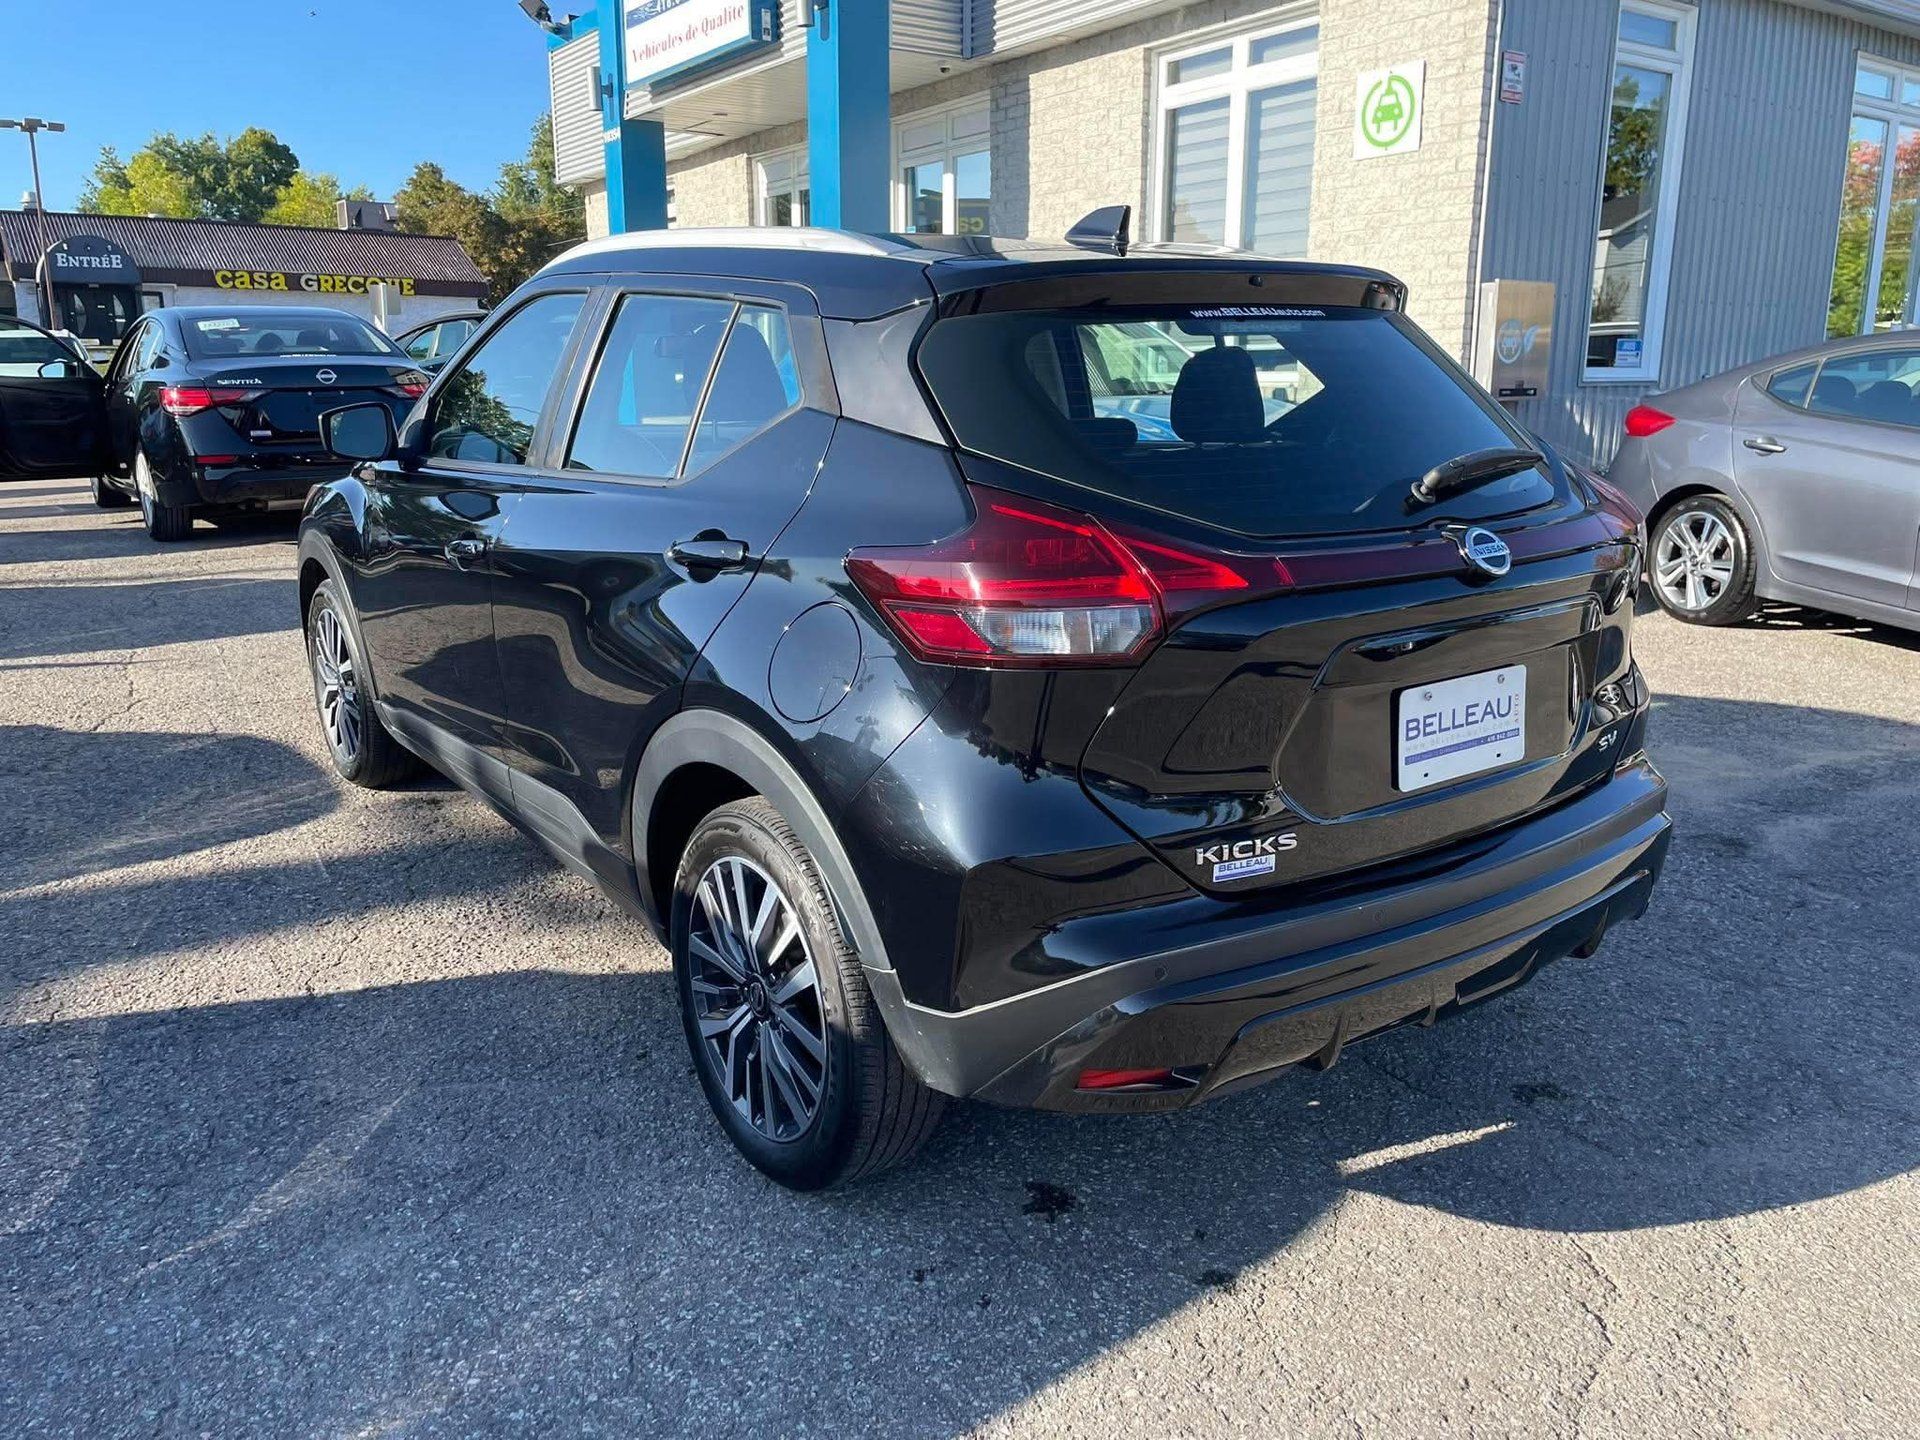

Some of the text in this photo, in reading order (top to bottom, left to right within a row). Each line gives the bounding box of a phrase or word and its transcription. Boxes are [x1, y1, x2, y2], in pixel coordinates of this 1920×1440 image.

[1473, 543, 1508, 556] NISSAN
[1405, 695, 1512, 741] BELLEAU
[1599, 730, 1617, 752] SV
[1196, 833, 1297, 865] KICKS
[1218, 858, 1268, 872] BELLEAU
